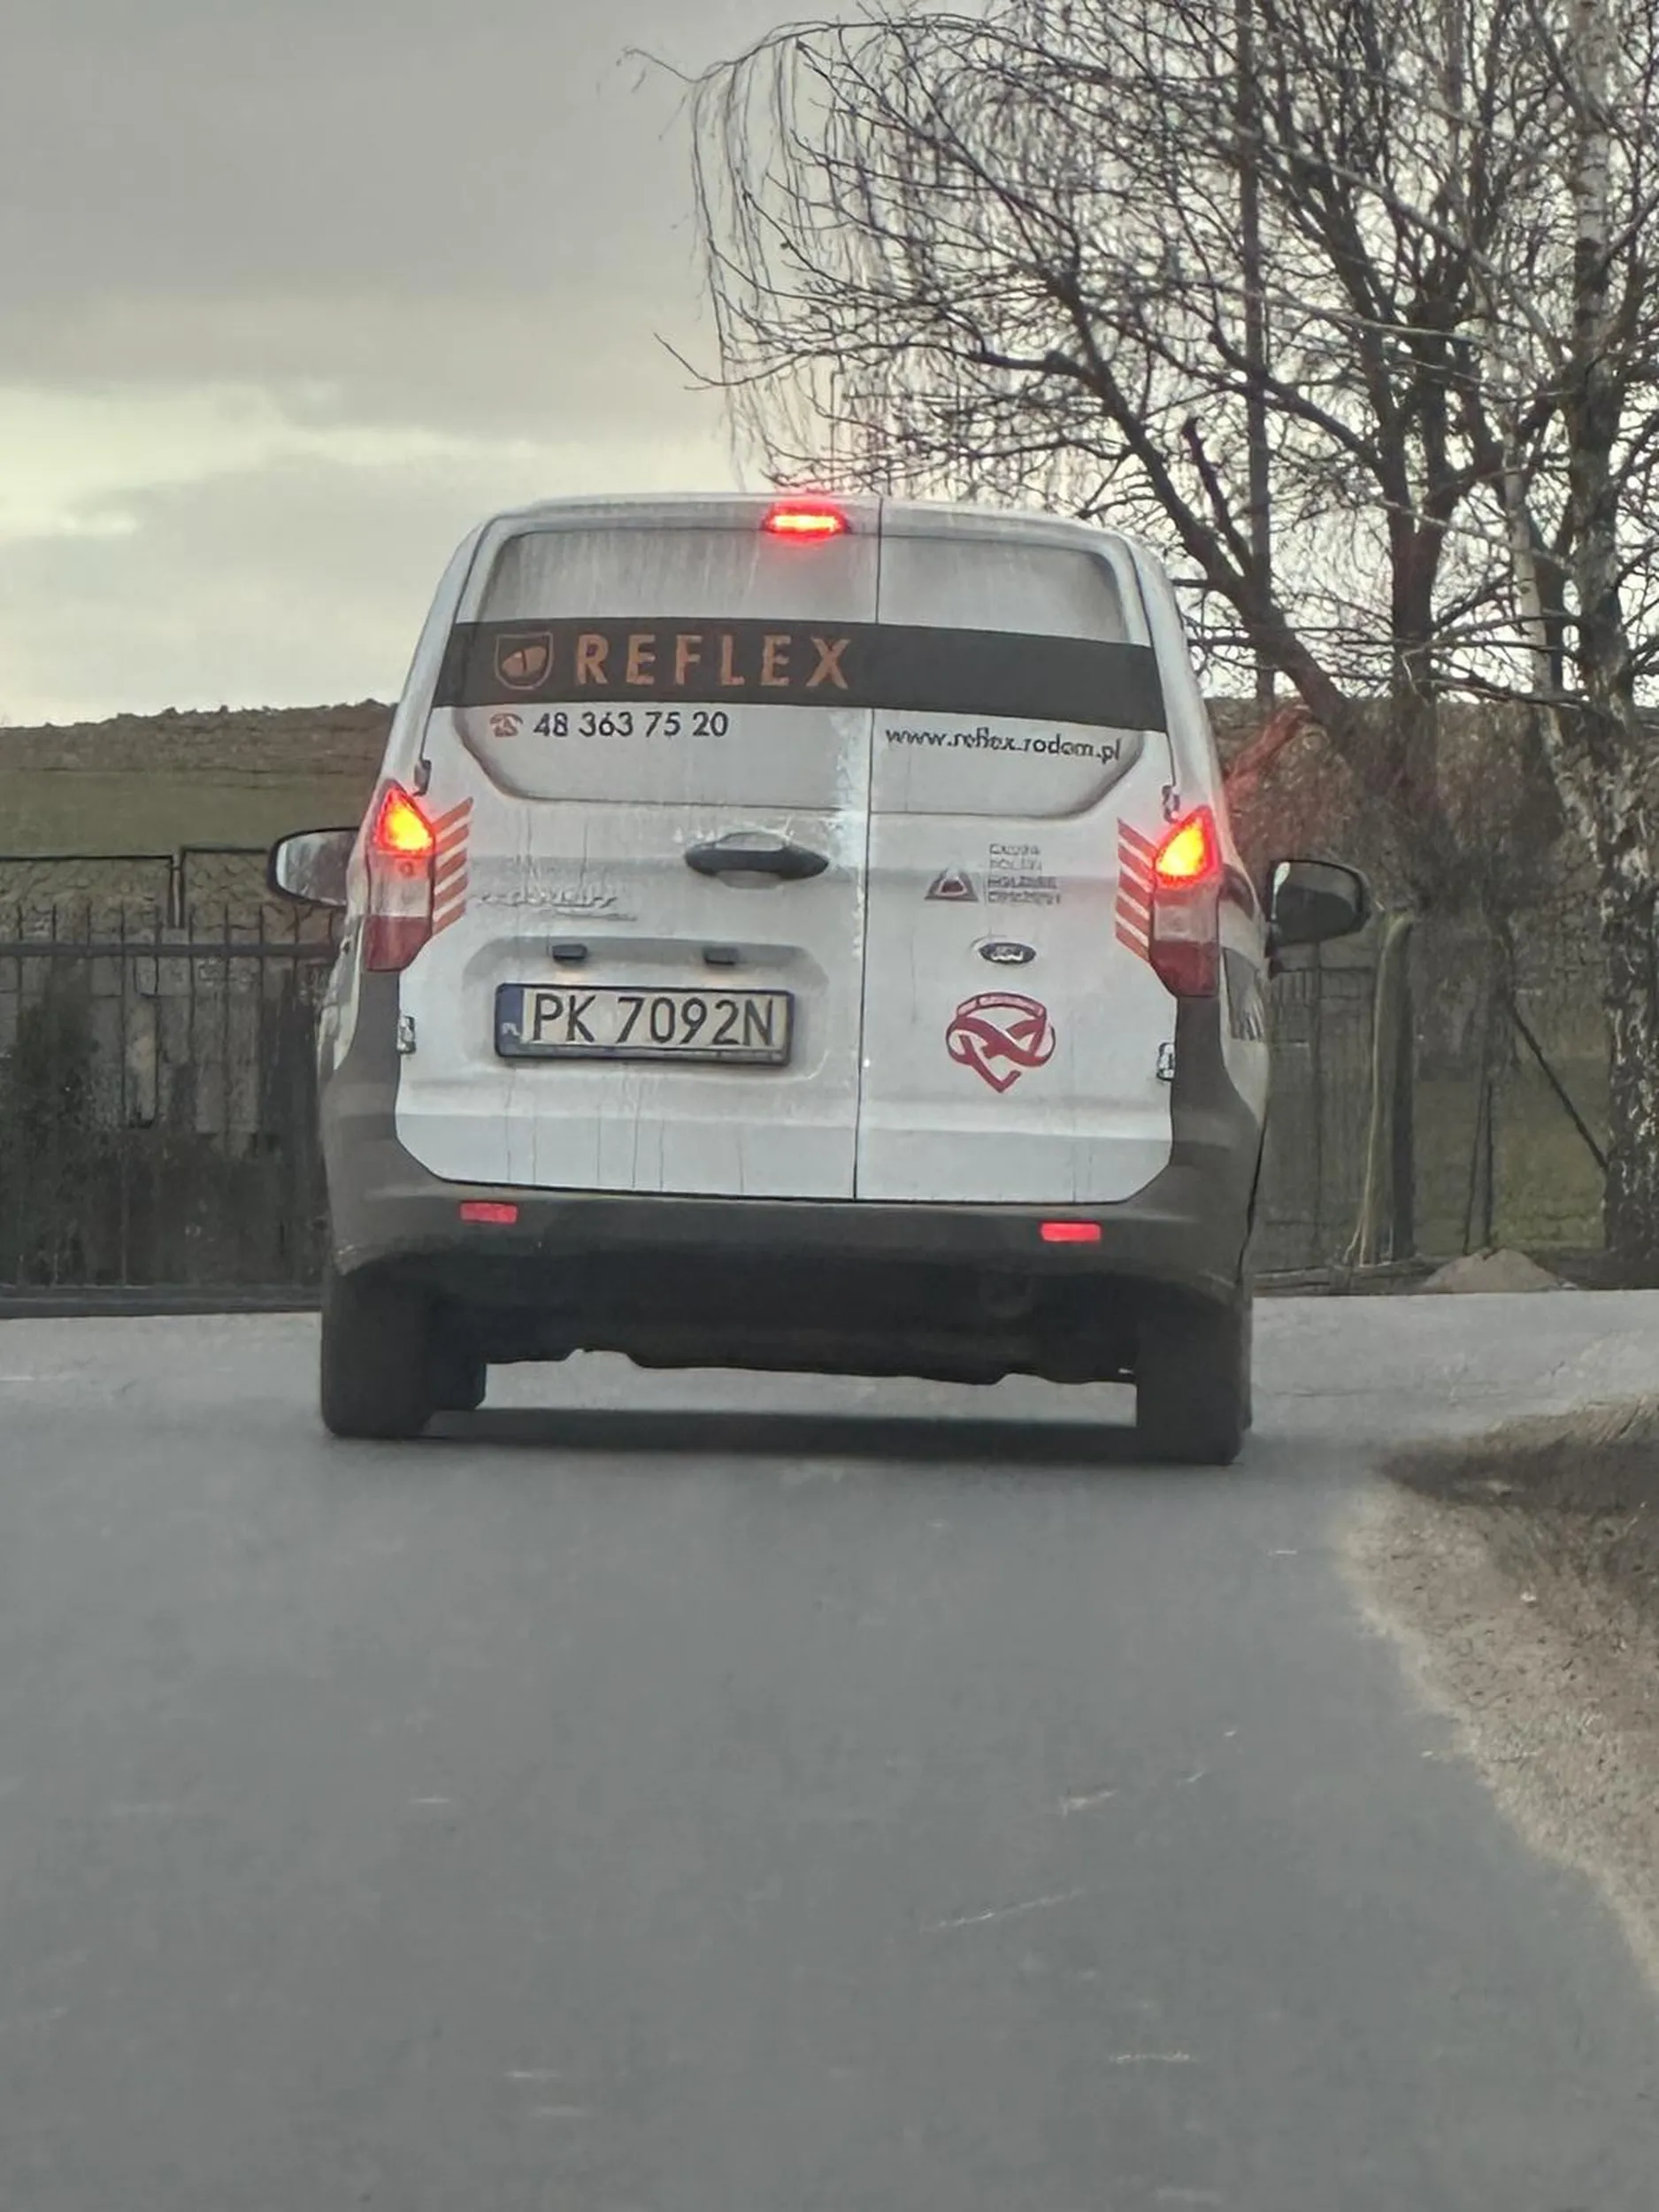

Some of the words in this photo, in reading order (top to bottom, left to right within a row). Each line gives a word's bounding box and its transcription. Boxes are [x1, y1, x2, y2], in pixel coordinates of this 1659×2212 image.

[574, 633, 852, 689] REFLEX
[533, 711, 569, 737] 48
[578, 710, 634, 738] 363
[644, 710, 682, 738] 75
[692, 710, 729, 737] 20
[533, 993, 597, 1043] PK
[615, 996, 774, 1047] 7092N
